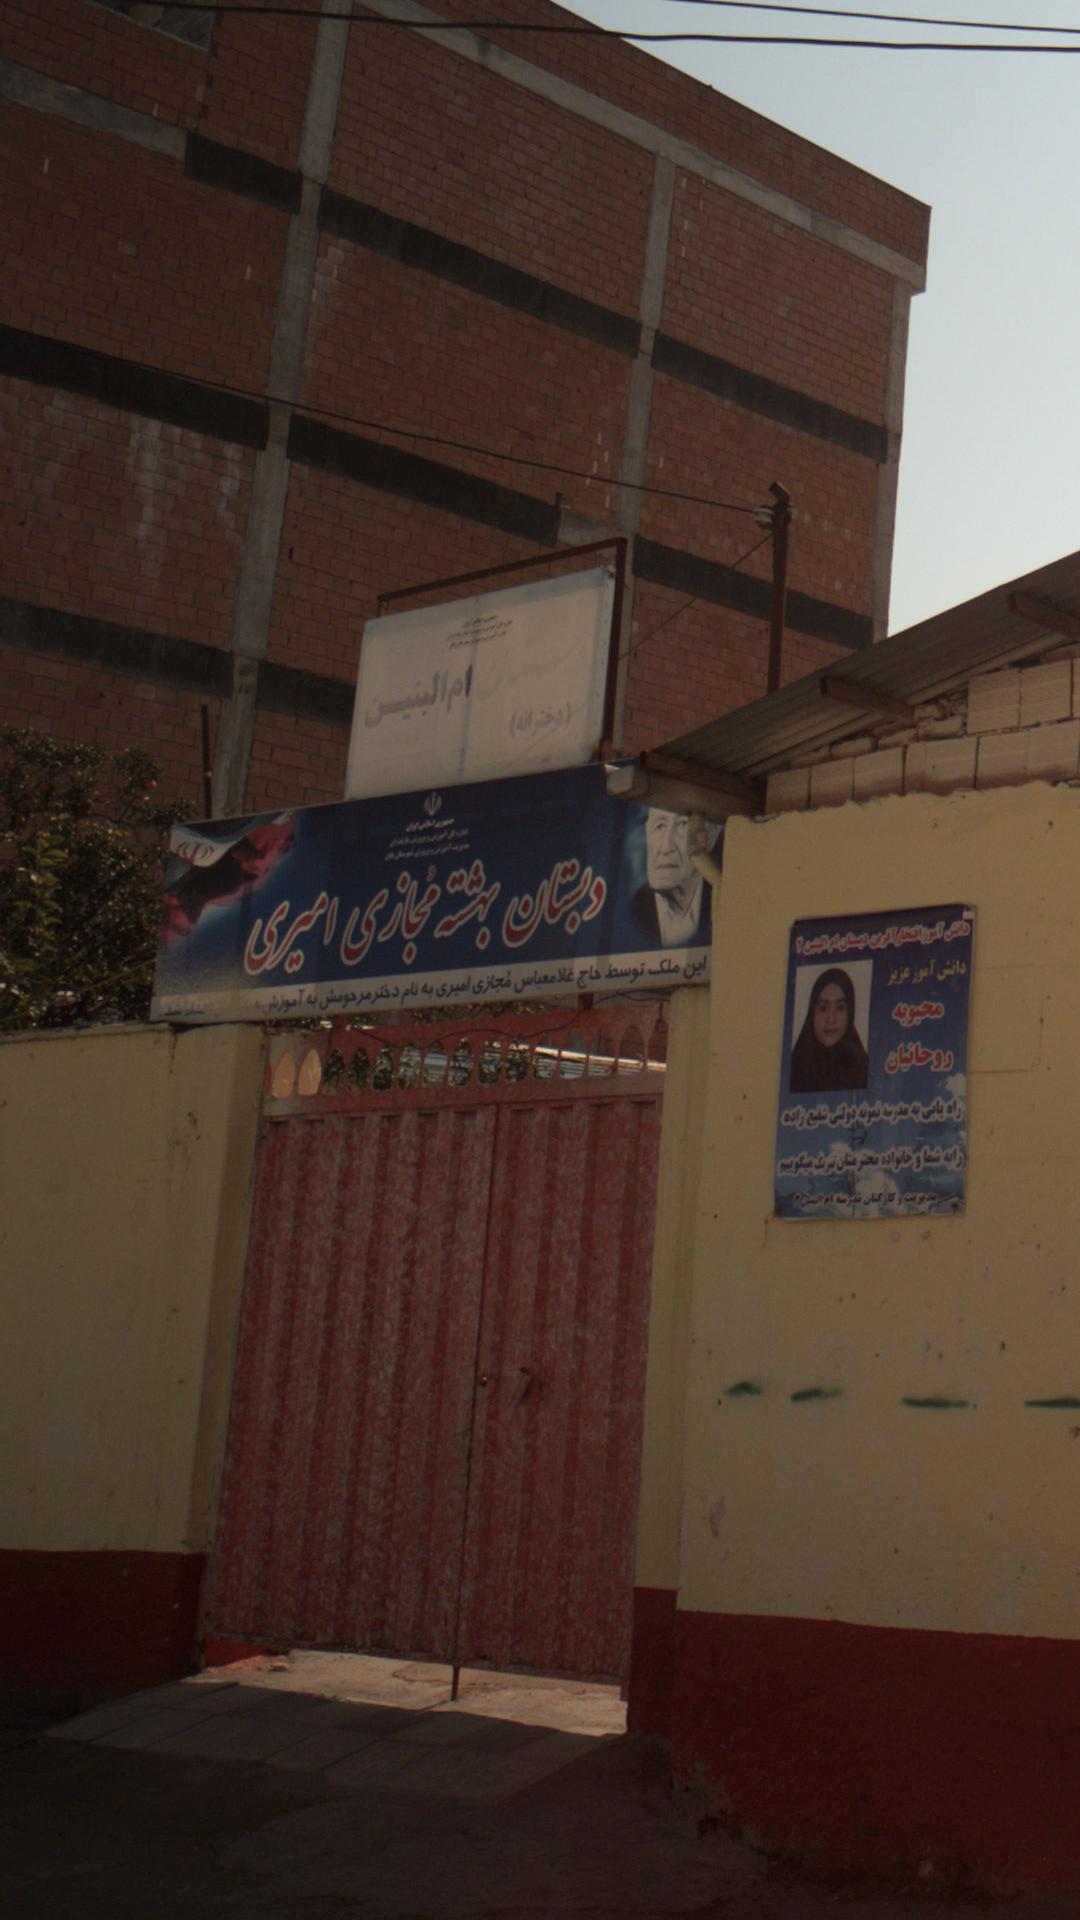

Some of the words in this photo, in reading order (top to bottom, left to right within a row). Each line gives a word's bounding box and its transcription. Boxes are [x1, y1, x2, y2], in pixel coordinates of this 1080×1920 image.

[447, 663, 473, 713] ام
[501, 858, 607, 948] دبستان
[244, 891, 339, 976] امیری
[944, 920, 970, 942] دانش
[576, 964, 602, 989] حاج
[605, 962, 645, 984] توسط
[648, 959, 679, 976] ملک
[683, 955, 707, 979] این
[887, 966, 910, 986] عزیز
[911, 959, 936, 985] آموز
[936, 959, 967, 981] دانش
[400, 982, 418, 1005] نام
[421, 981, 434, 999] به
[436, 975, 471, 998] امیری
[306, 993, 318, 1008] به
[891, 1001, 944, 1027] محبوبه
[885, 1041, 954, 1074] روحانیان
[782, 1104, 806, 1129] زاده
[829, 1102, 857, 1128] دولتی
[857, 1101, 881, 1126] نمونه
[881, 1102, 910, 1124] مدرسه
[910, 1101, 921, 1122] به
[945, 1095, 964, 1121] راه
[880, 1146, 912, 1171] خانواده
[911, 1152, 923, 1172] و
[921, 1145, 942, 1167] شما
